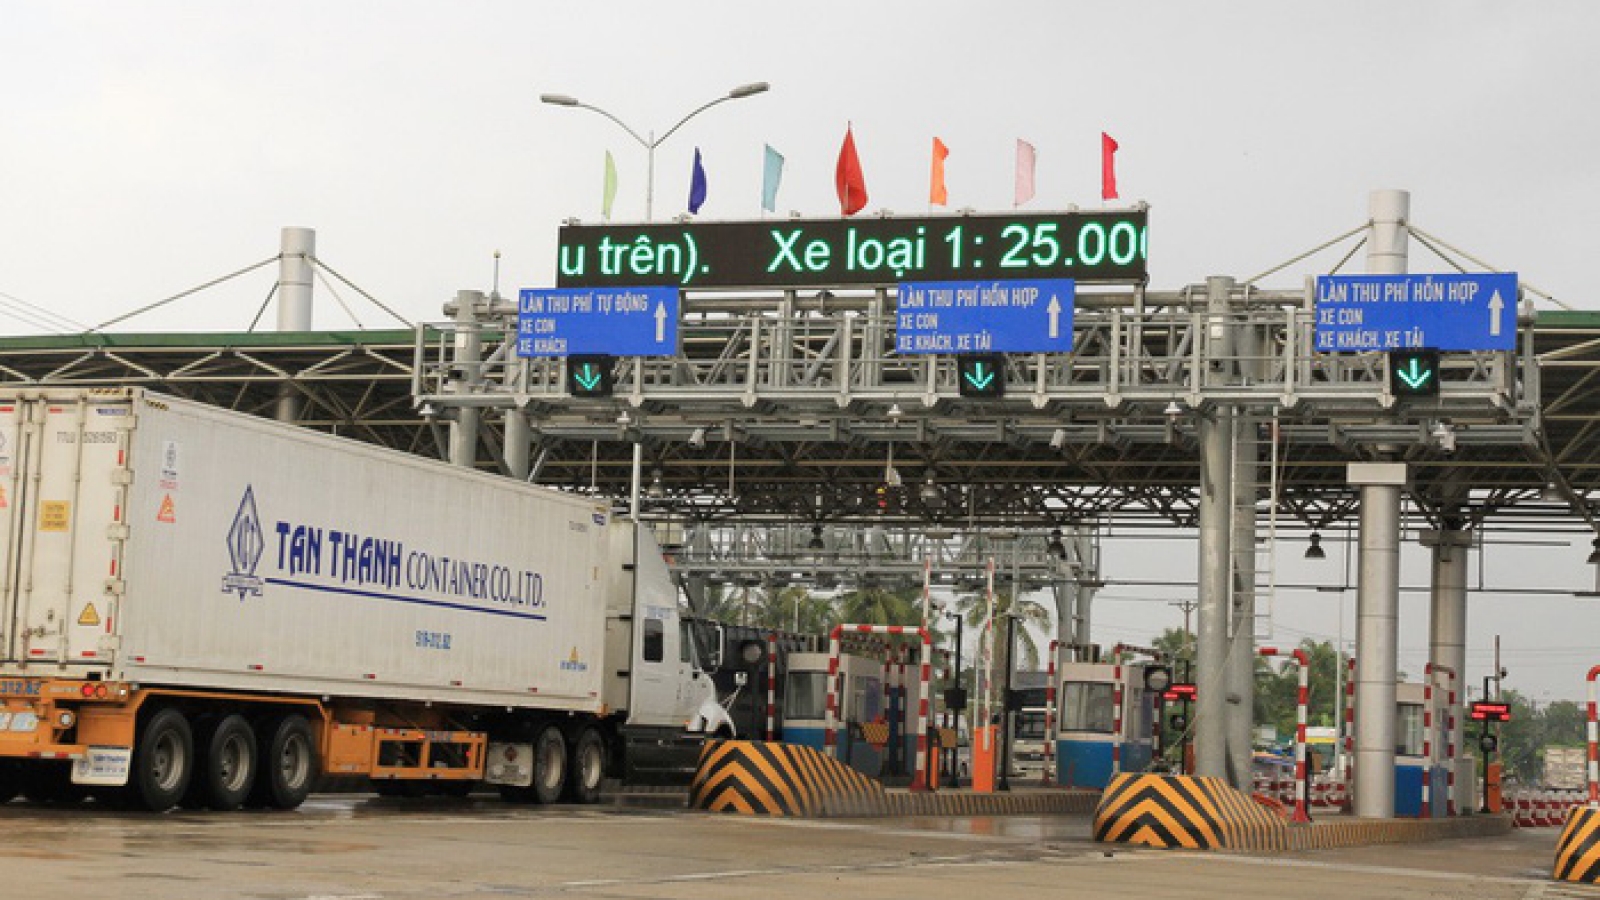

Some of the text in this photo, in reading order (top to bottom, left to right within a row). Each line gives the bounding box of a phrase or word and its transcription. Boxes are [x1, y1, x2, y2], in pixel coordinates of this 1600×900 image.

[560, 244, 586, 276] u
[599, 231, 710, 284] trên).
[767, 229, 832, 273] Xe
[846, 226, 926, 278] loại
[944, 225, 984, 269] 1:
[928, 289, 954, 307] THU
[956, 284, 980, 307] PHÍ
[1012, 287, 1039, 309] HỢP
[1320, 278, 1347, 302] LÀN
[1351, 283, 1379, 302] THU
[1385, 278, 1411, 302] PHÍ
[1449, 281, 1480, 305] HỢP
[546, 296, 570, 314] THU
[900, 313, 938, 330] XE CON
[1319, 307, 1363, 325] XE CON
[899, 335, 913, 350] XE
[957, 335, 971, 350] XE
[1318, 331, 1334, 347] XE
[1385, 331, 1400, 347] XE
[276, 521, 322, 576] TAN
[329, 530, 403, 589] THANH
[407, 550, 488, 599] CONTAINER
